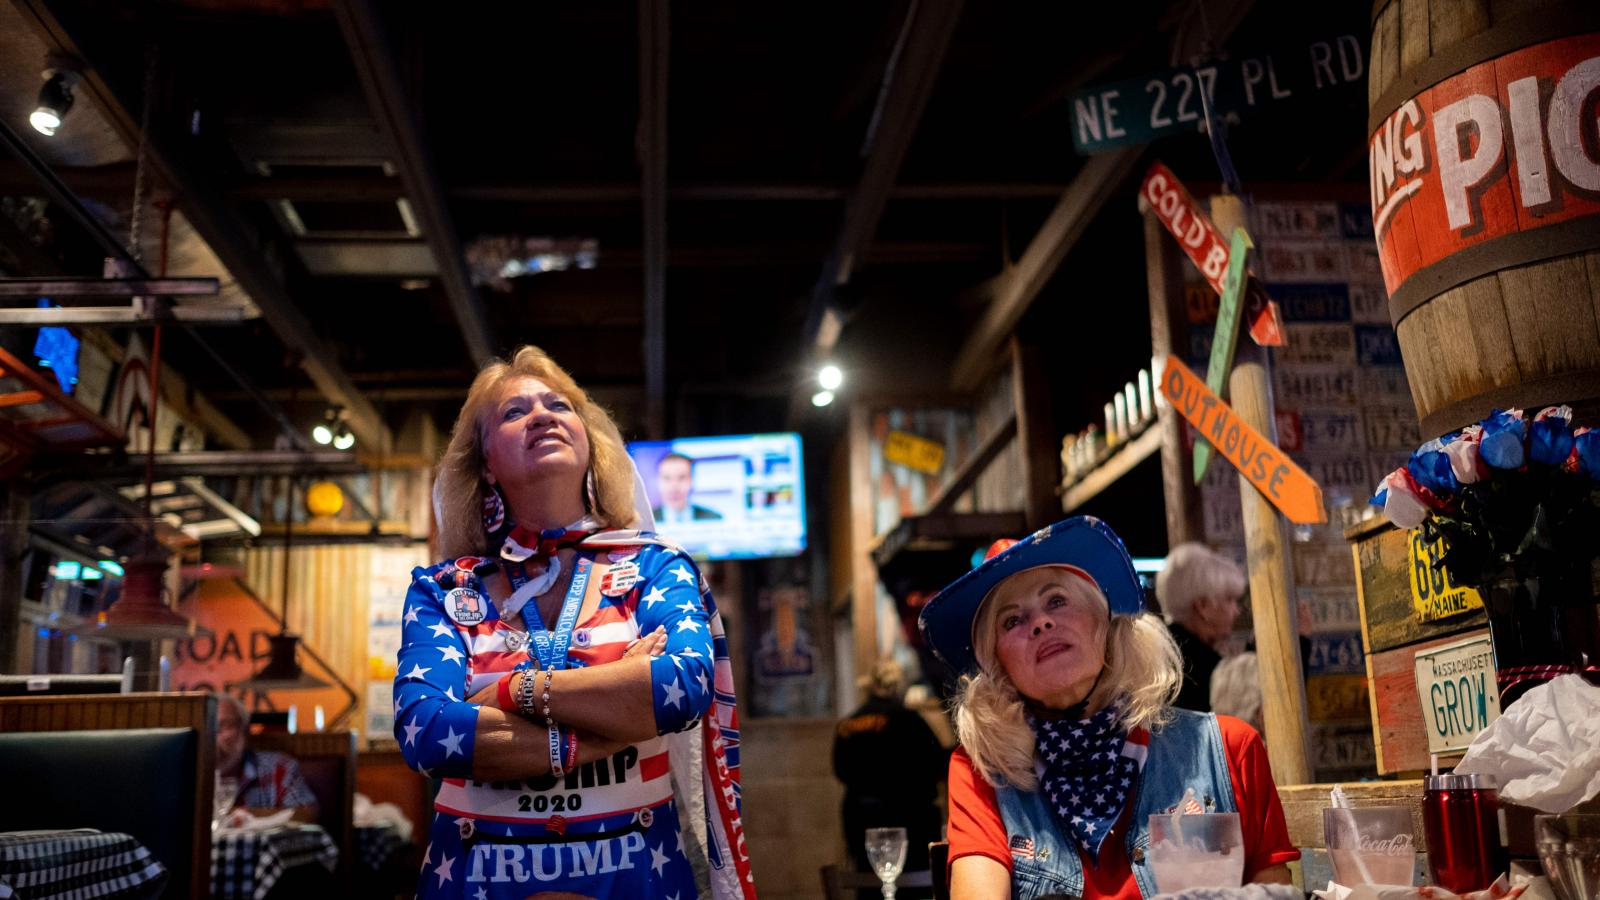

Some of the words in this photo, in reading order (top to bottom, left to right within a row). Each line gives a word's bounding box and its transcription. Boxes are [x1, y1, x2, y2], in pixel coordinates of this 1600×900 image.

[1075, 90, 1126, 144] NE
[1145, 67, 1220, 130] 227
[1241, 57, 1293, 106] PL
[1309, 34, 1366, 89] RD
[1148, 173, 1206, 248] COLD
[1168, 371, 1290, 499] OUTHOUSE
[570, 574, 588, 596] KEEP
[557, 596, 580, 636] AMERICA
[1434, 592, 1467, 617] MAINE
[551, 634, 569, 665] GREAT
[1433, 652, 1494, 678] MASSACHUSETT
[517, 794, 582, 813] 2020
[466, 831, 646, 883] TRUMP
